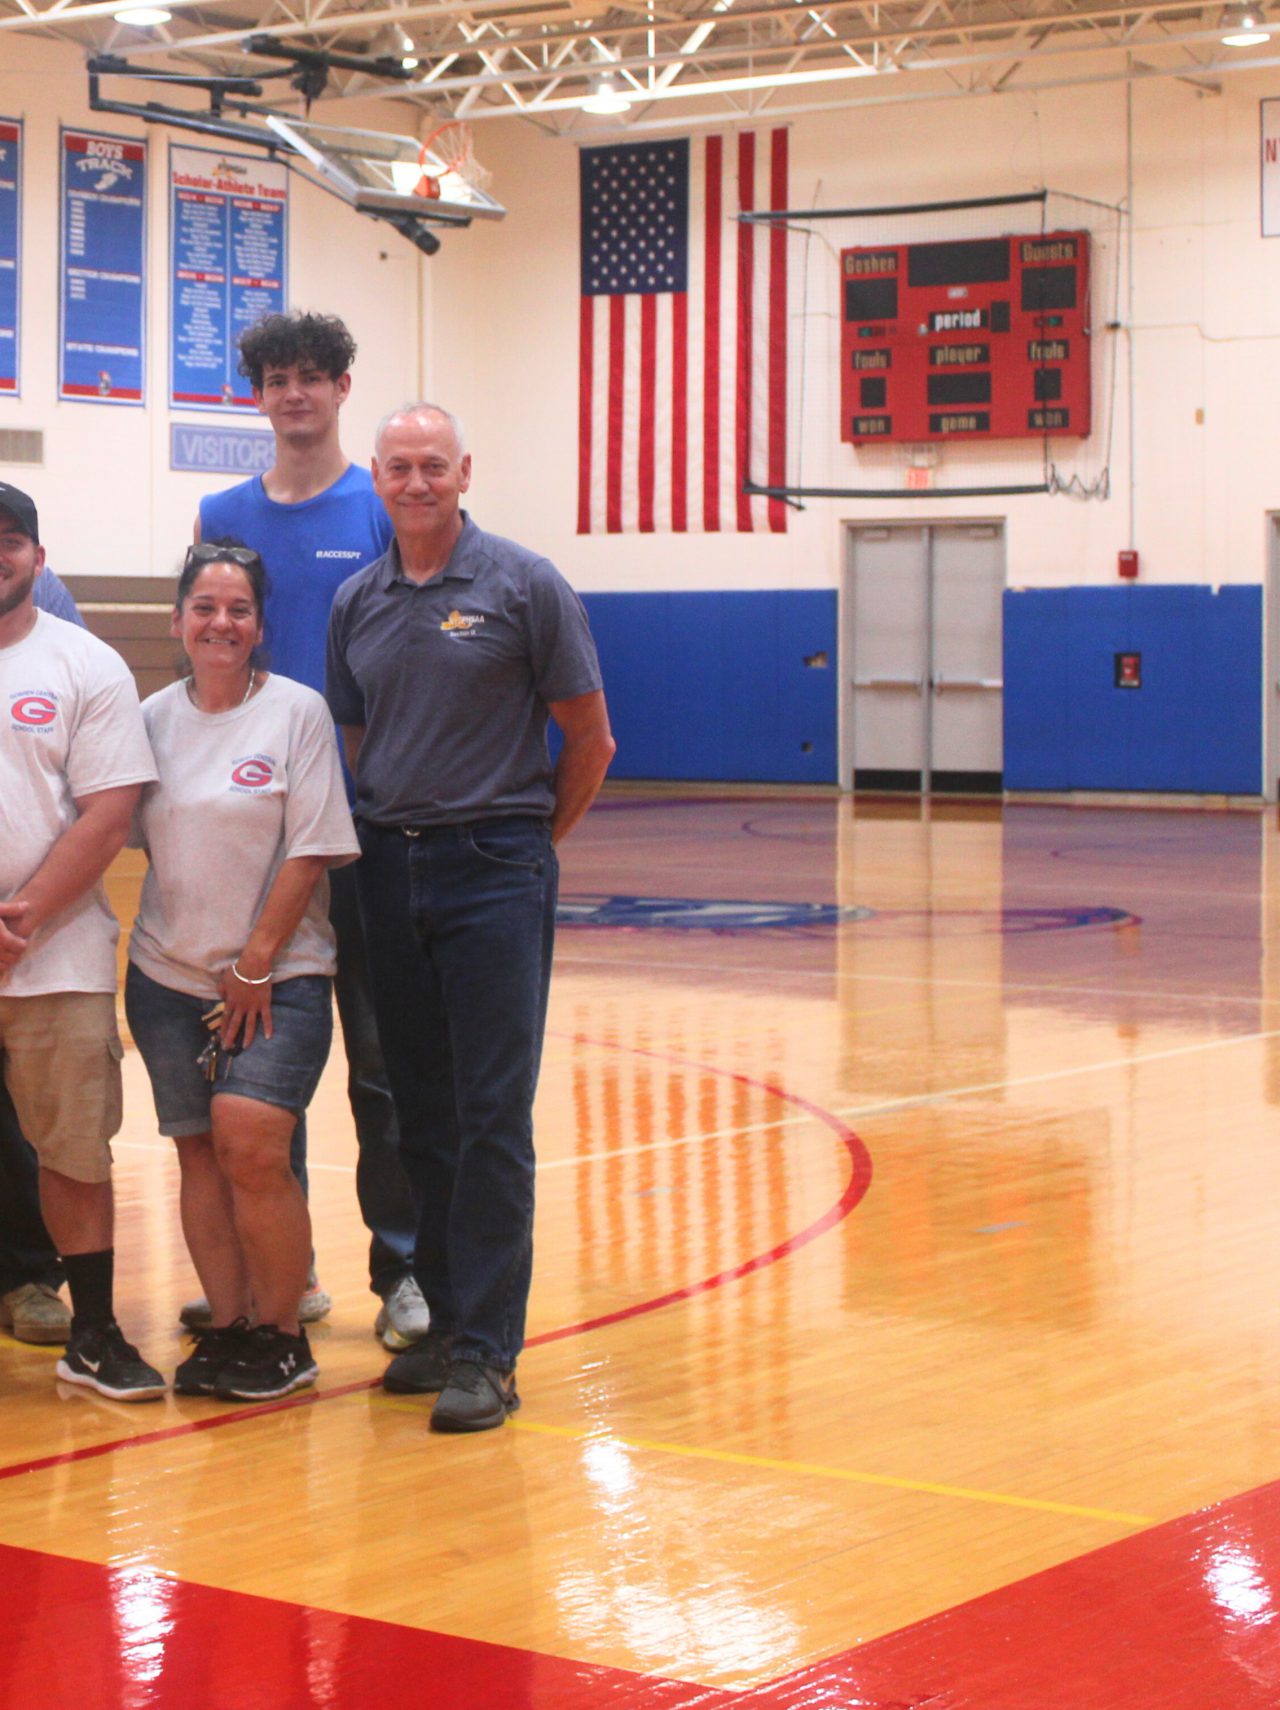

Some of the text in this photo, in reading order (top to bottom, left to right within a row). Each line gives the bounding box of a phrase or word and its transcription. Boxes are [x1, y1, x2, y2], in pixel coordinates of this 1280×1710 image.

[86, 141, 124, 159] BOYS
[1265, 137, 1278, 163] N
[75, 158, 134, 181] TRACK
[173, 171, 288, 199] Scholar-Athlete Team
[845, 242, 1073, 274] Goshen Guests
[934, 309, 982, 332] period
[854, 350, 888, 369] fouls
[936, 346, 981, 364] player
[858, 412, 1062, 433] won game won
[11, 696, 57, 725] G
[231, 759, 272, 787] G
